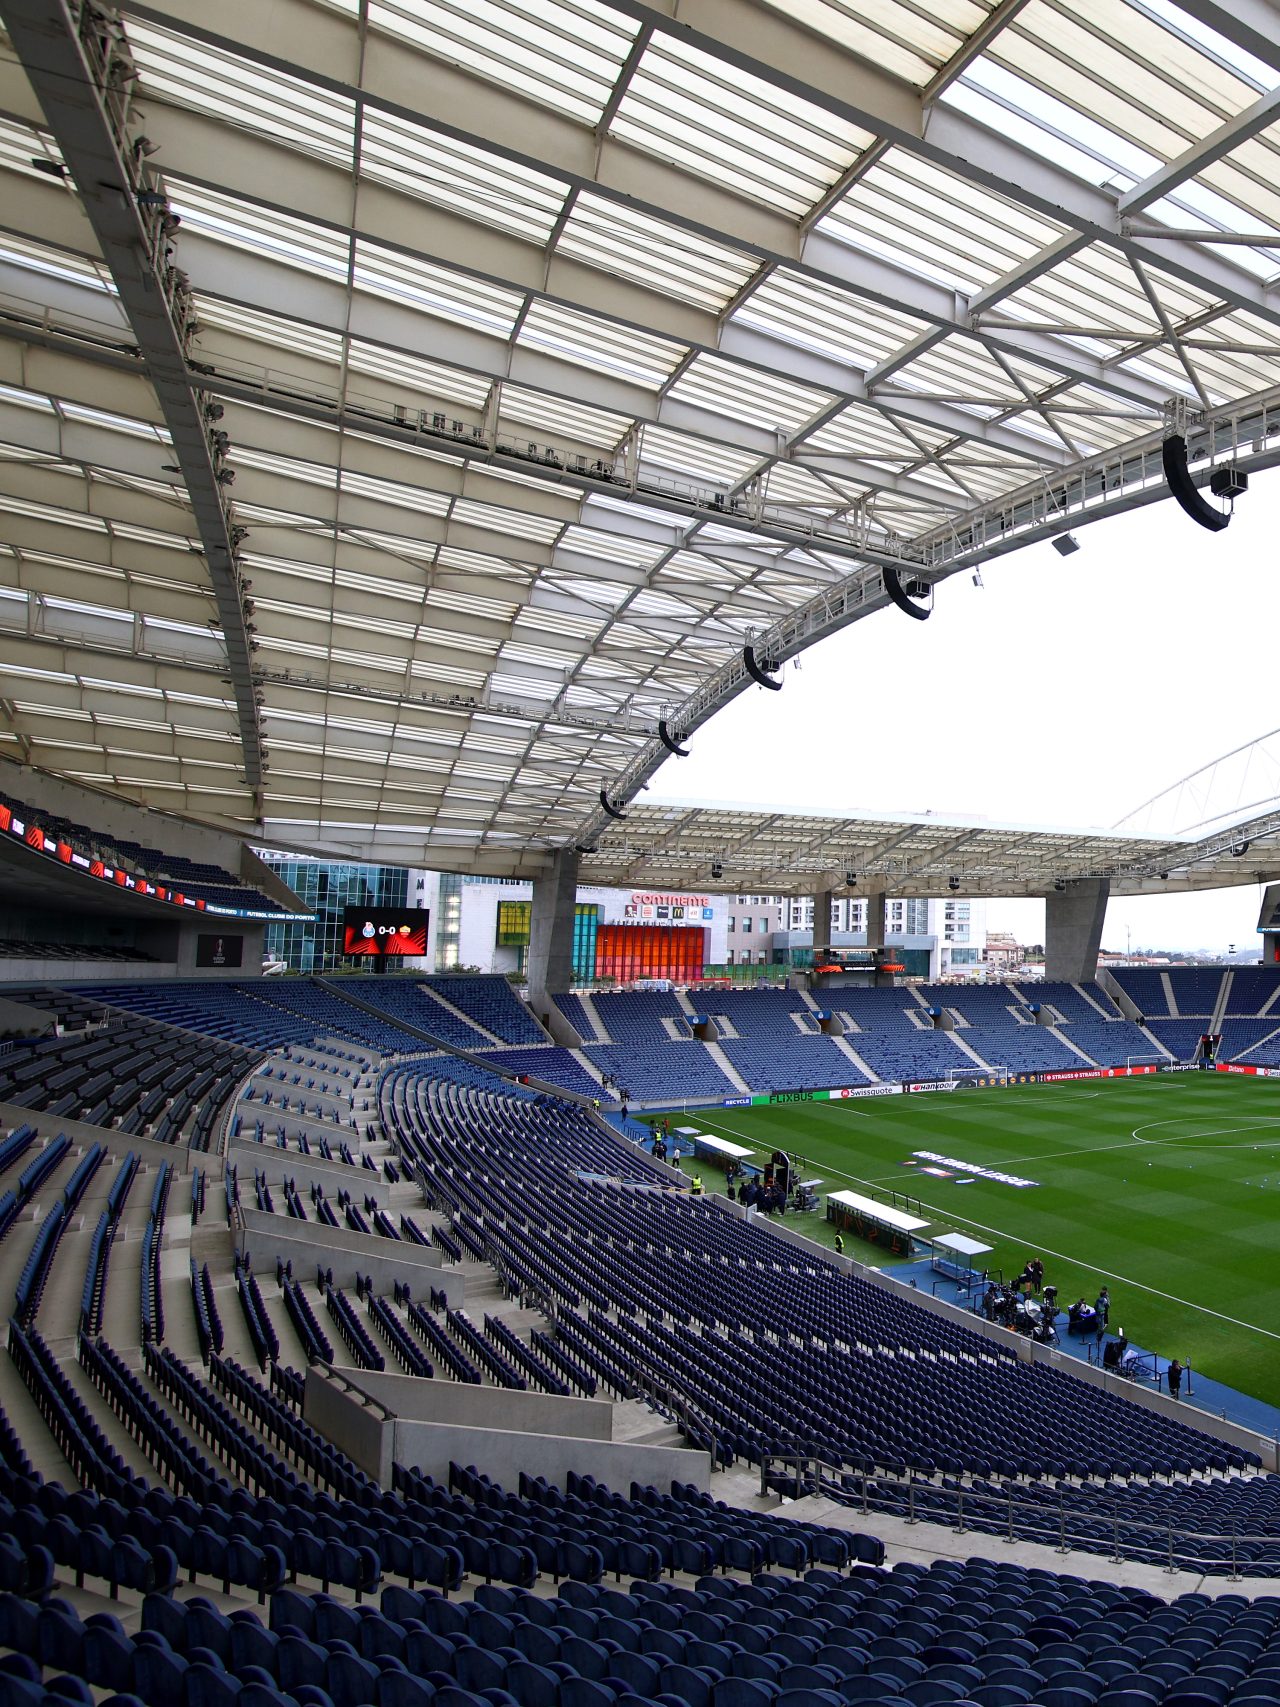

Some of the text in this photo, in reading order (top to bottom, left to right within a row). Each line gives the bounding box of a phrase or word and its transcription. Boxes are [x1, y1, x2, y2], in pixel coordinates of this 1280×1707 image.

[378, 926, 396, 935] 0-0
[850, 1086, 893, 1097] Swissquote
[725, 1098, 750, 1106] RECYCLE
